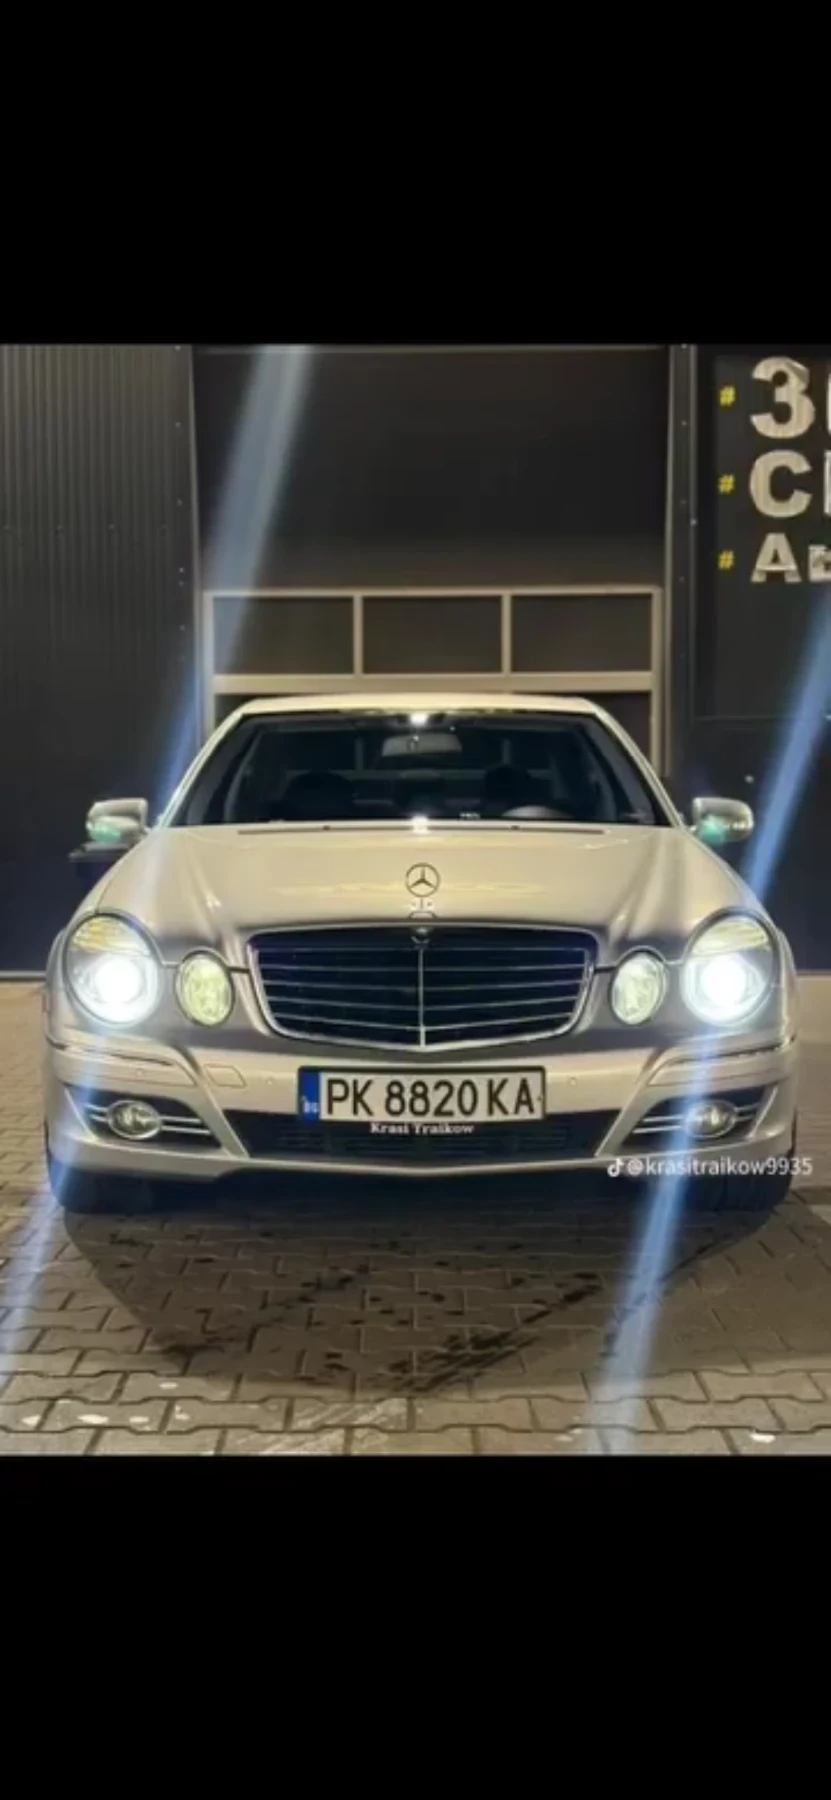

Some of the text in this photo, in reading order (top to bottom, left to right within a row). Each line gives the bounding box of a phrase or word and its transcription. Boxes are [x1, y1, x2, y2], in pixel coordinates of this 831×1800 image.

[750, 450, 831, 518] С
[327, 1078, 535, 1117] PK 8820 KA
